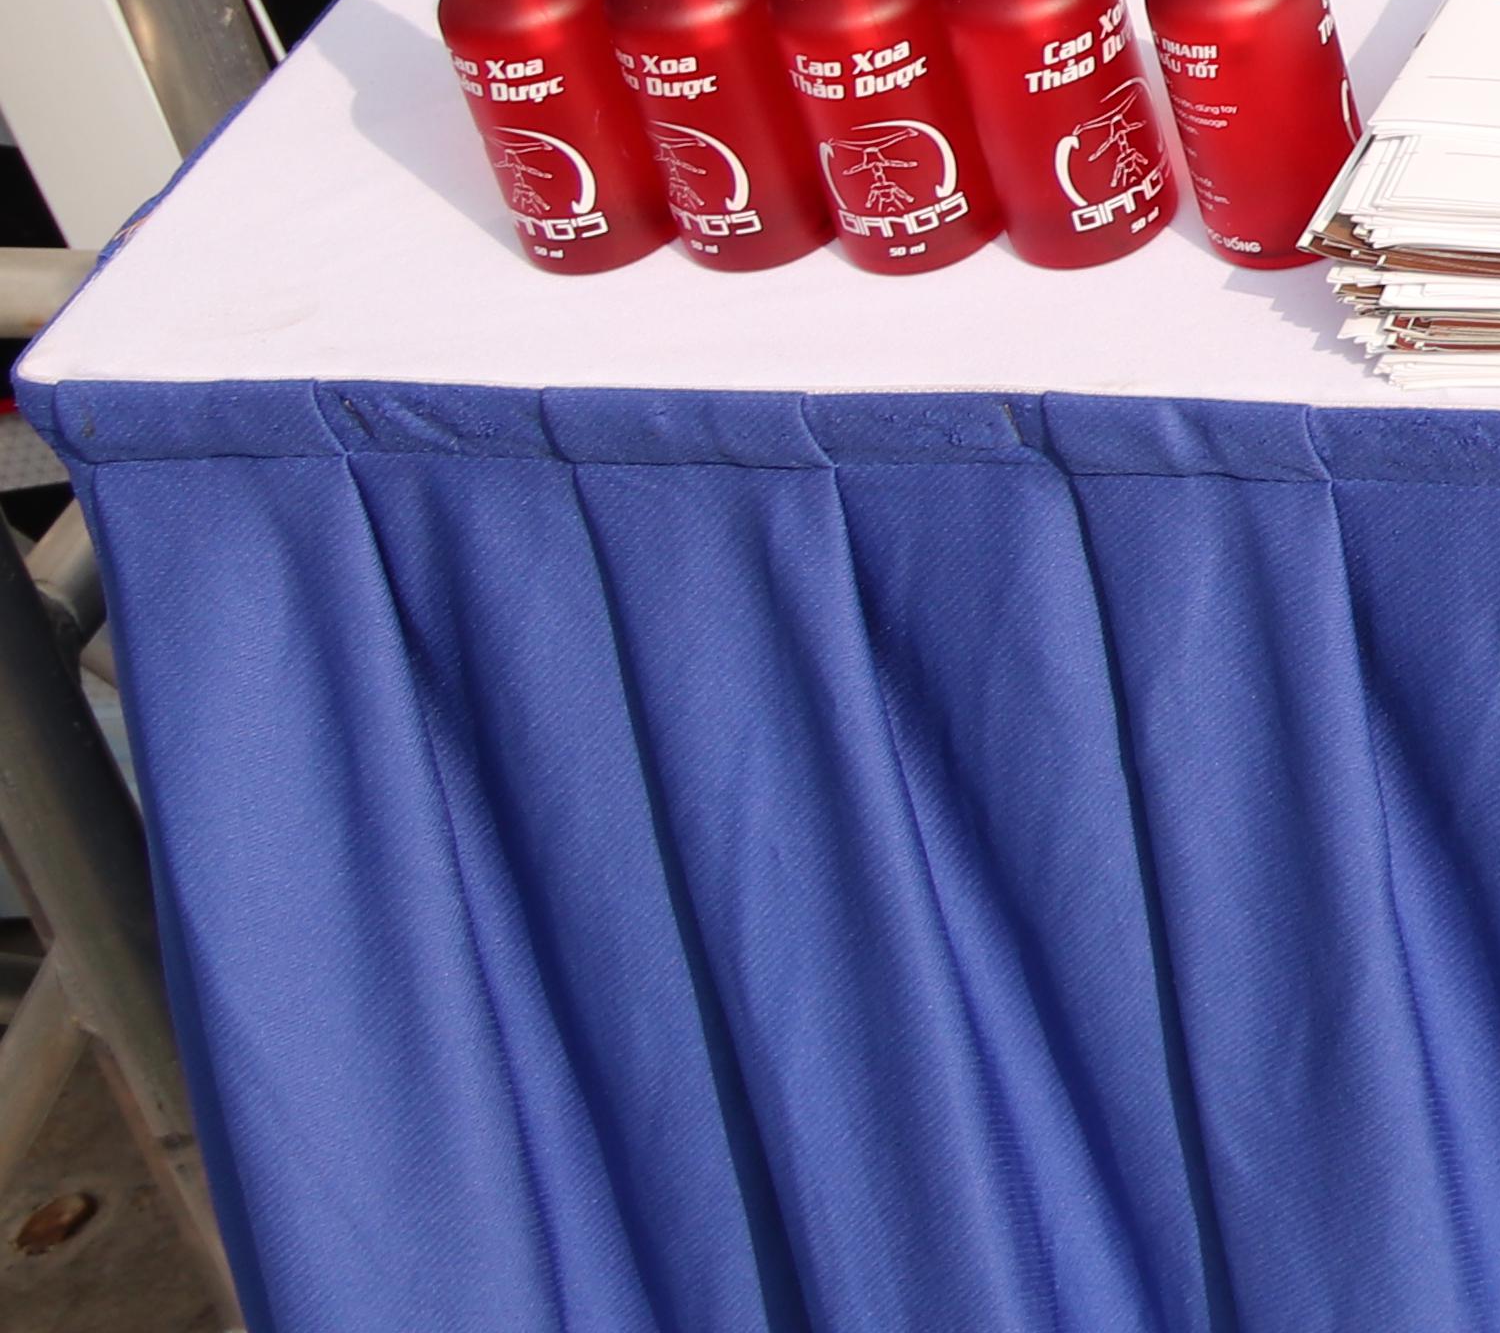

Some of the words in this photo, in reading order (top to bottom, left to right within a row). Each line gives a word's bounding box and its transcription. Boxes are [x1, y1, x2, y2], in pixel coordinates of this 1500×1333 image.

[794, 53, 842, 78] Cao
[852, 40, 911, 75] Xoa
[1042, 30, 1094, 67] Cao
[1162, 37, 1218, 60] NHANH
[485, 57, 545, 80] Xoa
[640, 55, 698, 76] Xoa
[788, 67, 845, 100] Thảo
[854, 56, 929, 98] Dược
[1024, 54, 1096, 95] Thảo
[1185, 59, 1219, 80] TỐT
[489, 76, 565, 104] Dược
[645, 75, 719, 101] Dược
[838, 191, 970, 239] GIANG'S
[888, 245, 906, 258] 50
[909, 242, 927, 256] ml
